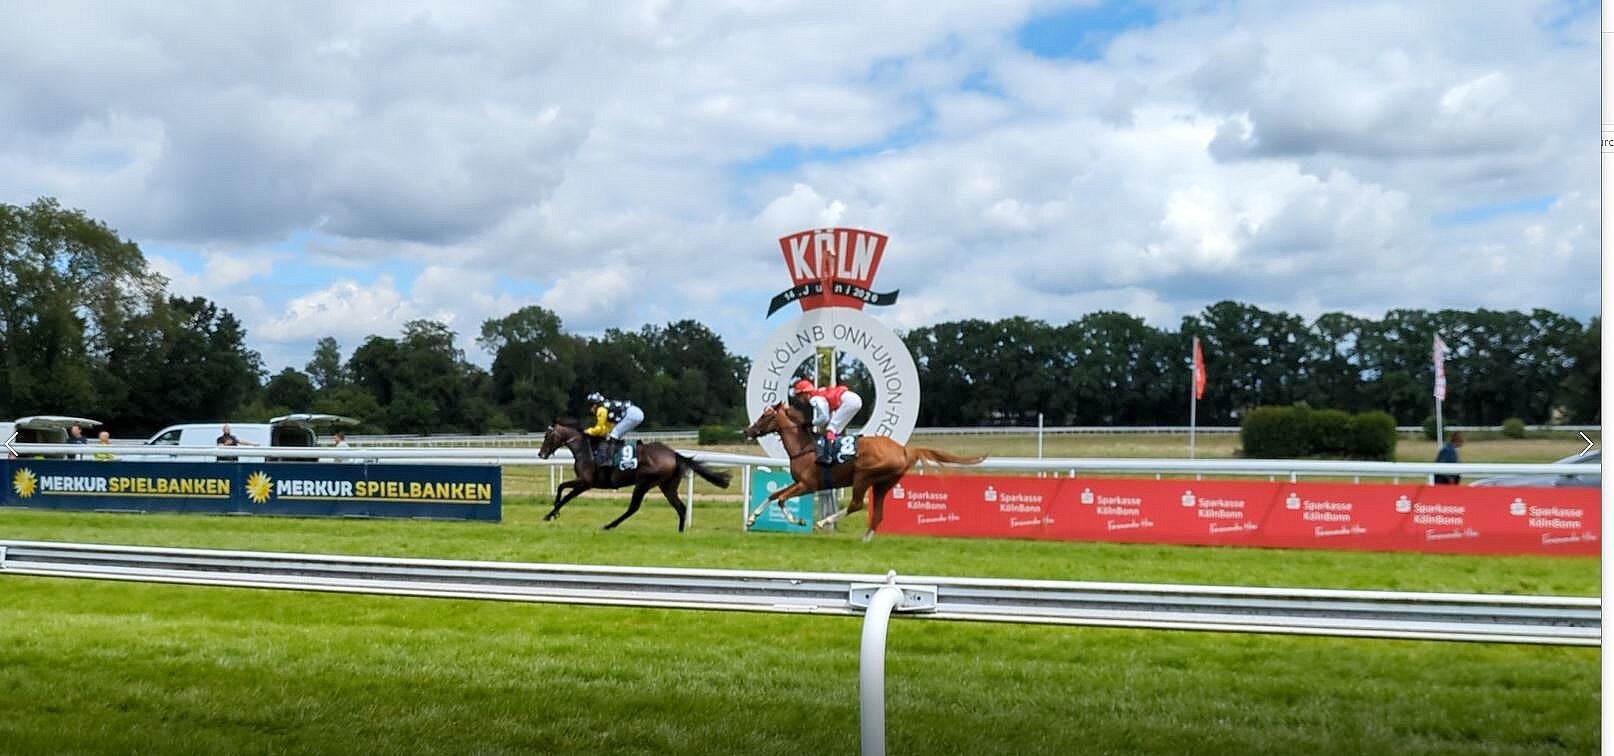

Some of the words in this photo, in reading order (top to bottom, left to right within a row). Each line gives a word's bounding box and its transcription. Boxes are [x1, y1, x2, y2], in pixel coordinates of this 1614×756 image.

[789, 229, 878, 281] KÖLN
[761, 378, 779, 412] SE
[622, 445, 634, 460] 9
[40, 475, 107, 492] MERKUR
[108, 477, 231, 494] SPIELBANKEN
[277, 479, 353, 497] MERKUR
[355, 480, 492, 500] SPIELBANKEN
[907, 490, 948, 501] Sparkasse
[1000, 492, 1043, 504] Sparkasse
[1097, 495, 1142, 506] Sparkasse
[1198, 497, 1245, 509] Sparkasse
